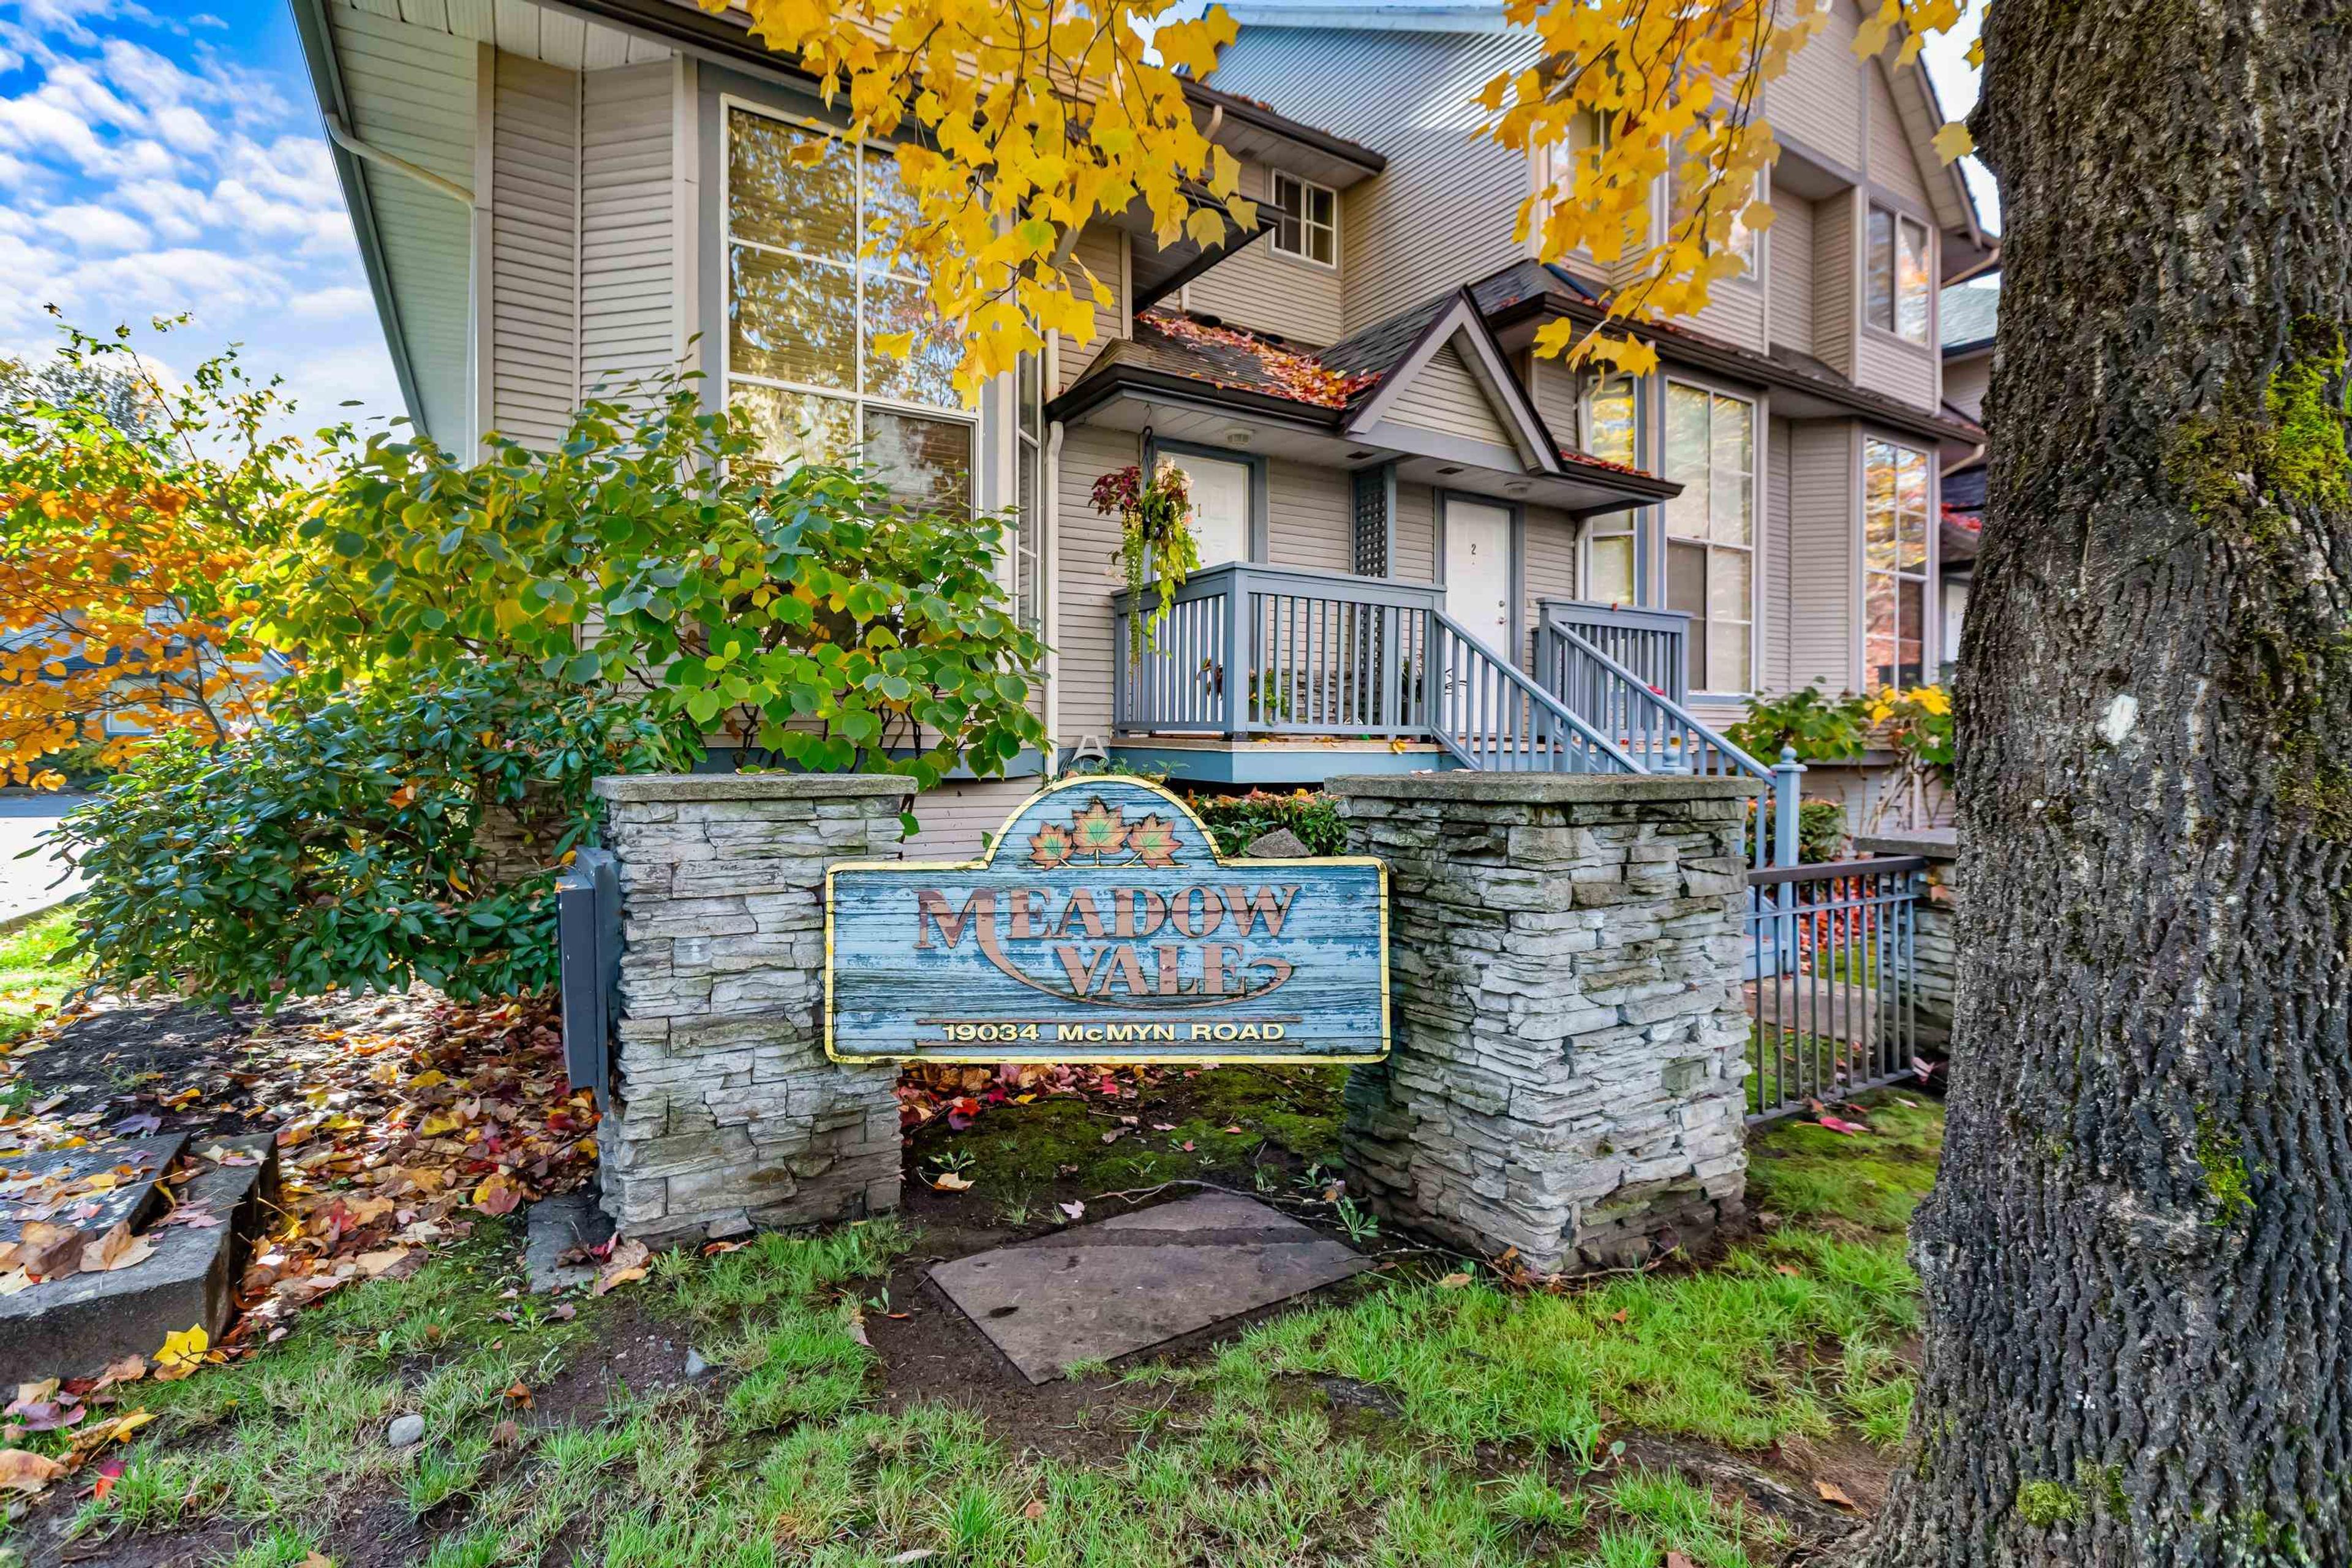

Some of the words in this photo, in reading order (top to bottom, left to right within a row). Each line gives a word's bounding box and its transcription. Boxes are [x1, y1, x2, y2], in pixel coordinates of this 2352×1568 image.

[1471, 543, 1476, 555] 2
[912, 886, 1301, 949] MEADOW
[1054, 944, 1246, 996] VALE
[943, 1023, 1040, 1041] 19034
[1057, 1023, 1175, 1041] McMYN
[1191, 1023, 1286, 1041] ROAD
